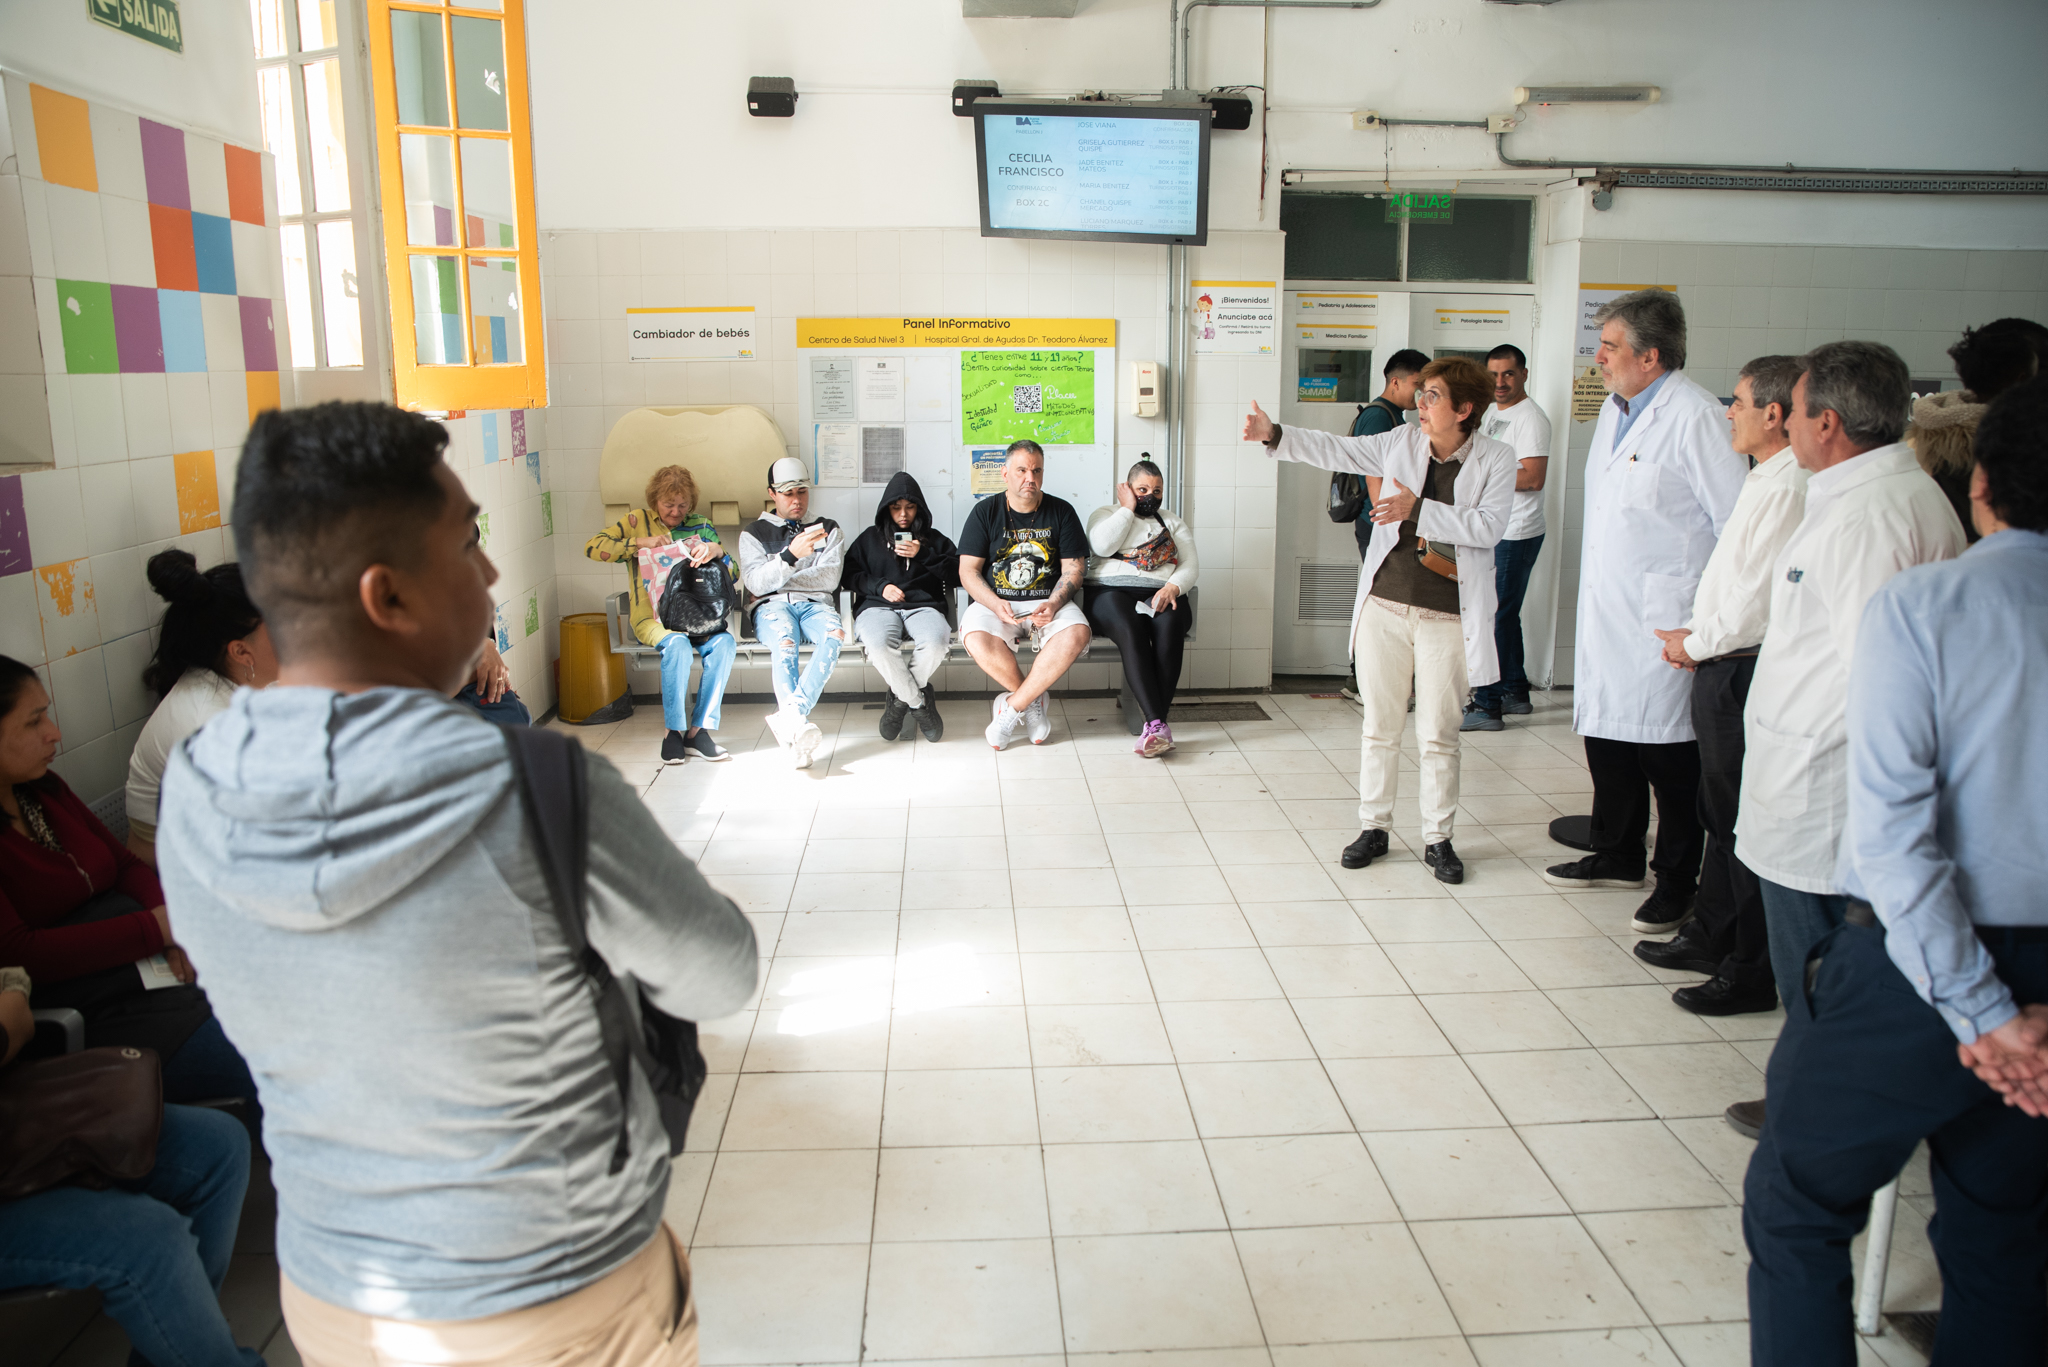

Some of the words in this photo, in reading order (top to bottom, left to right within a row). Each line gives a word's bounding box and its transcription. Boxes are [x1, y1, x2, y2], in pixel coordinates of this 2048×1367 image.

[123, 0, 179, 43] SALIDA
[1009, 153, 1053, 163] CECILIA
[998, 166, 1064, 177] FRANCISCO
[903, 318, 935, 329] Panel
[938, 318, 1011, 328] Informativo
[633, 329, 695, 339] Cambiador
[699, 328, 713, 338] de
[716, 328, 750, 338] bebés
[809, 336, 839, 344] Centro
[854, 336, 877, 344] Salud
[878, 335, 898, 344] Nivel
[899, 336, 904, 344] 3
[925, 335, 959, 345] Hospital
[996, 336, 1026, 345] Agudos
[1078, 334, 1108, 343] Álvarez
[1030, 352, 1042, 361] 11
[1050, 352, 1060, 362] 19
